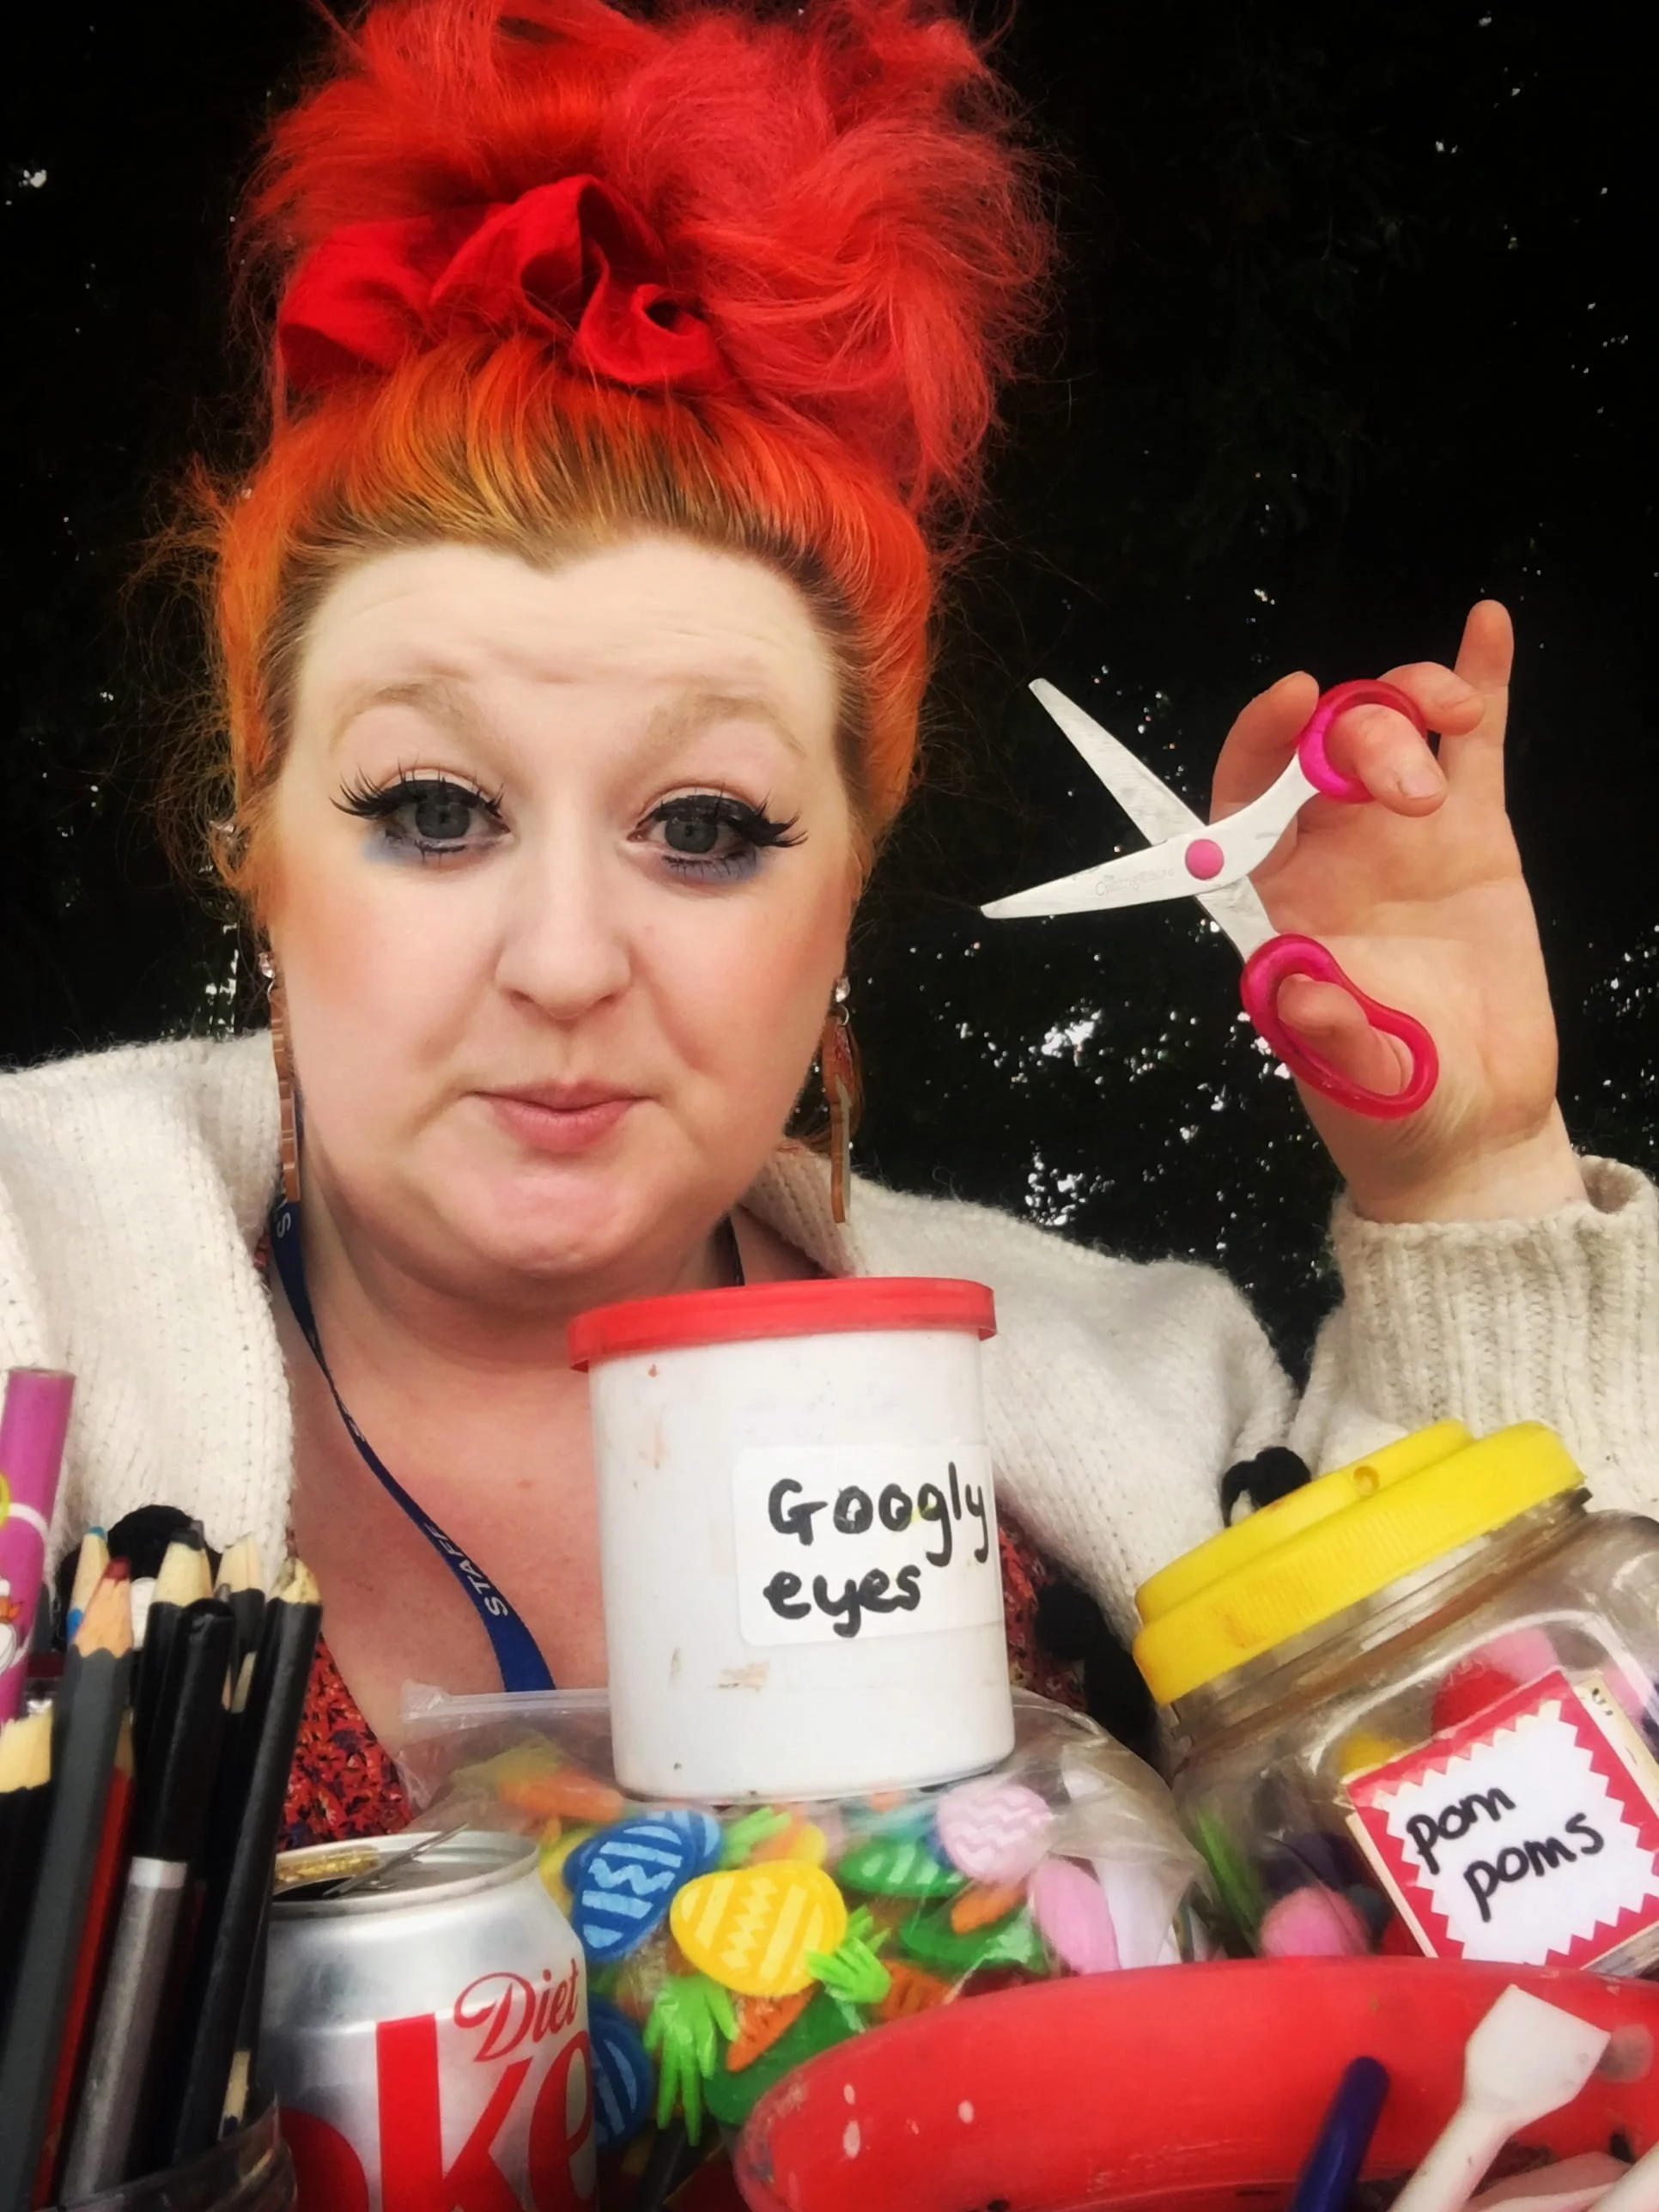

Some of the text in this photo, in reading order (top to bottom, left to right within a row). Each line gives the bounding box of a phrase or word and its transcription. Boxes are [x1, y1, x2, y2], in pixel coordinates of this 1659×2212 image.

[768, 1462, 988, 1567] Googly
[424, 1522, 508, 1616] STAFF
[763, 1565, 921, 1638] eyes
[1407, 1787, 1516, 1875] pom
[1463, 1813, 1604, 1923] poms
[453, 1958, 579, 2062] Diet
